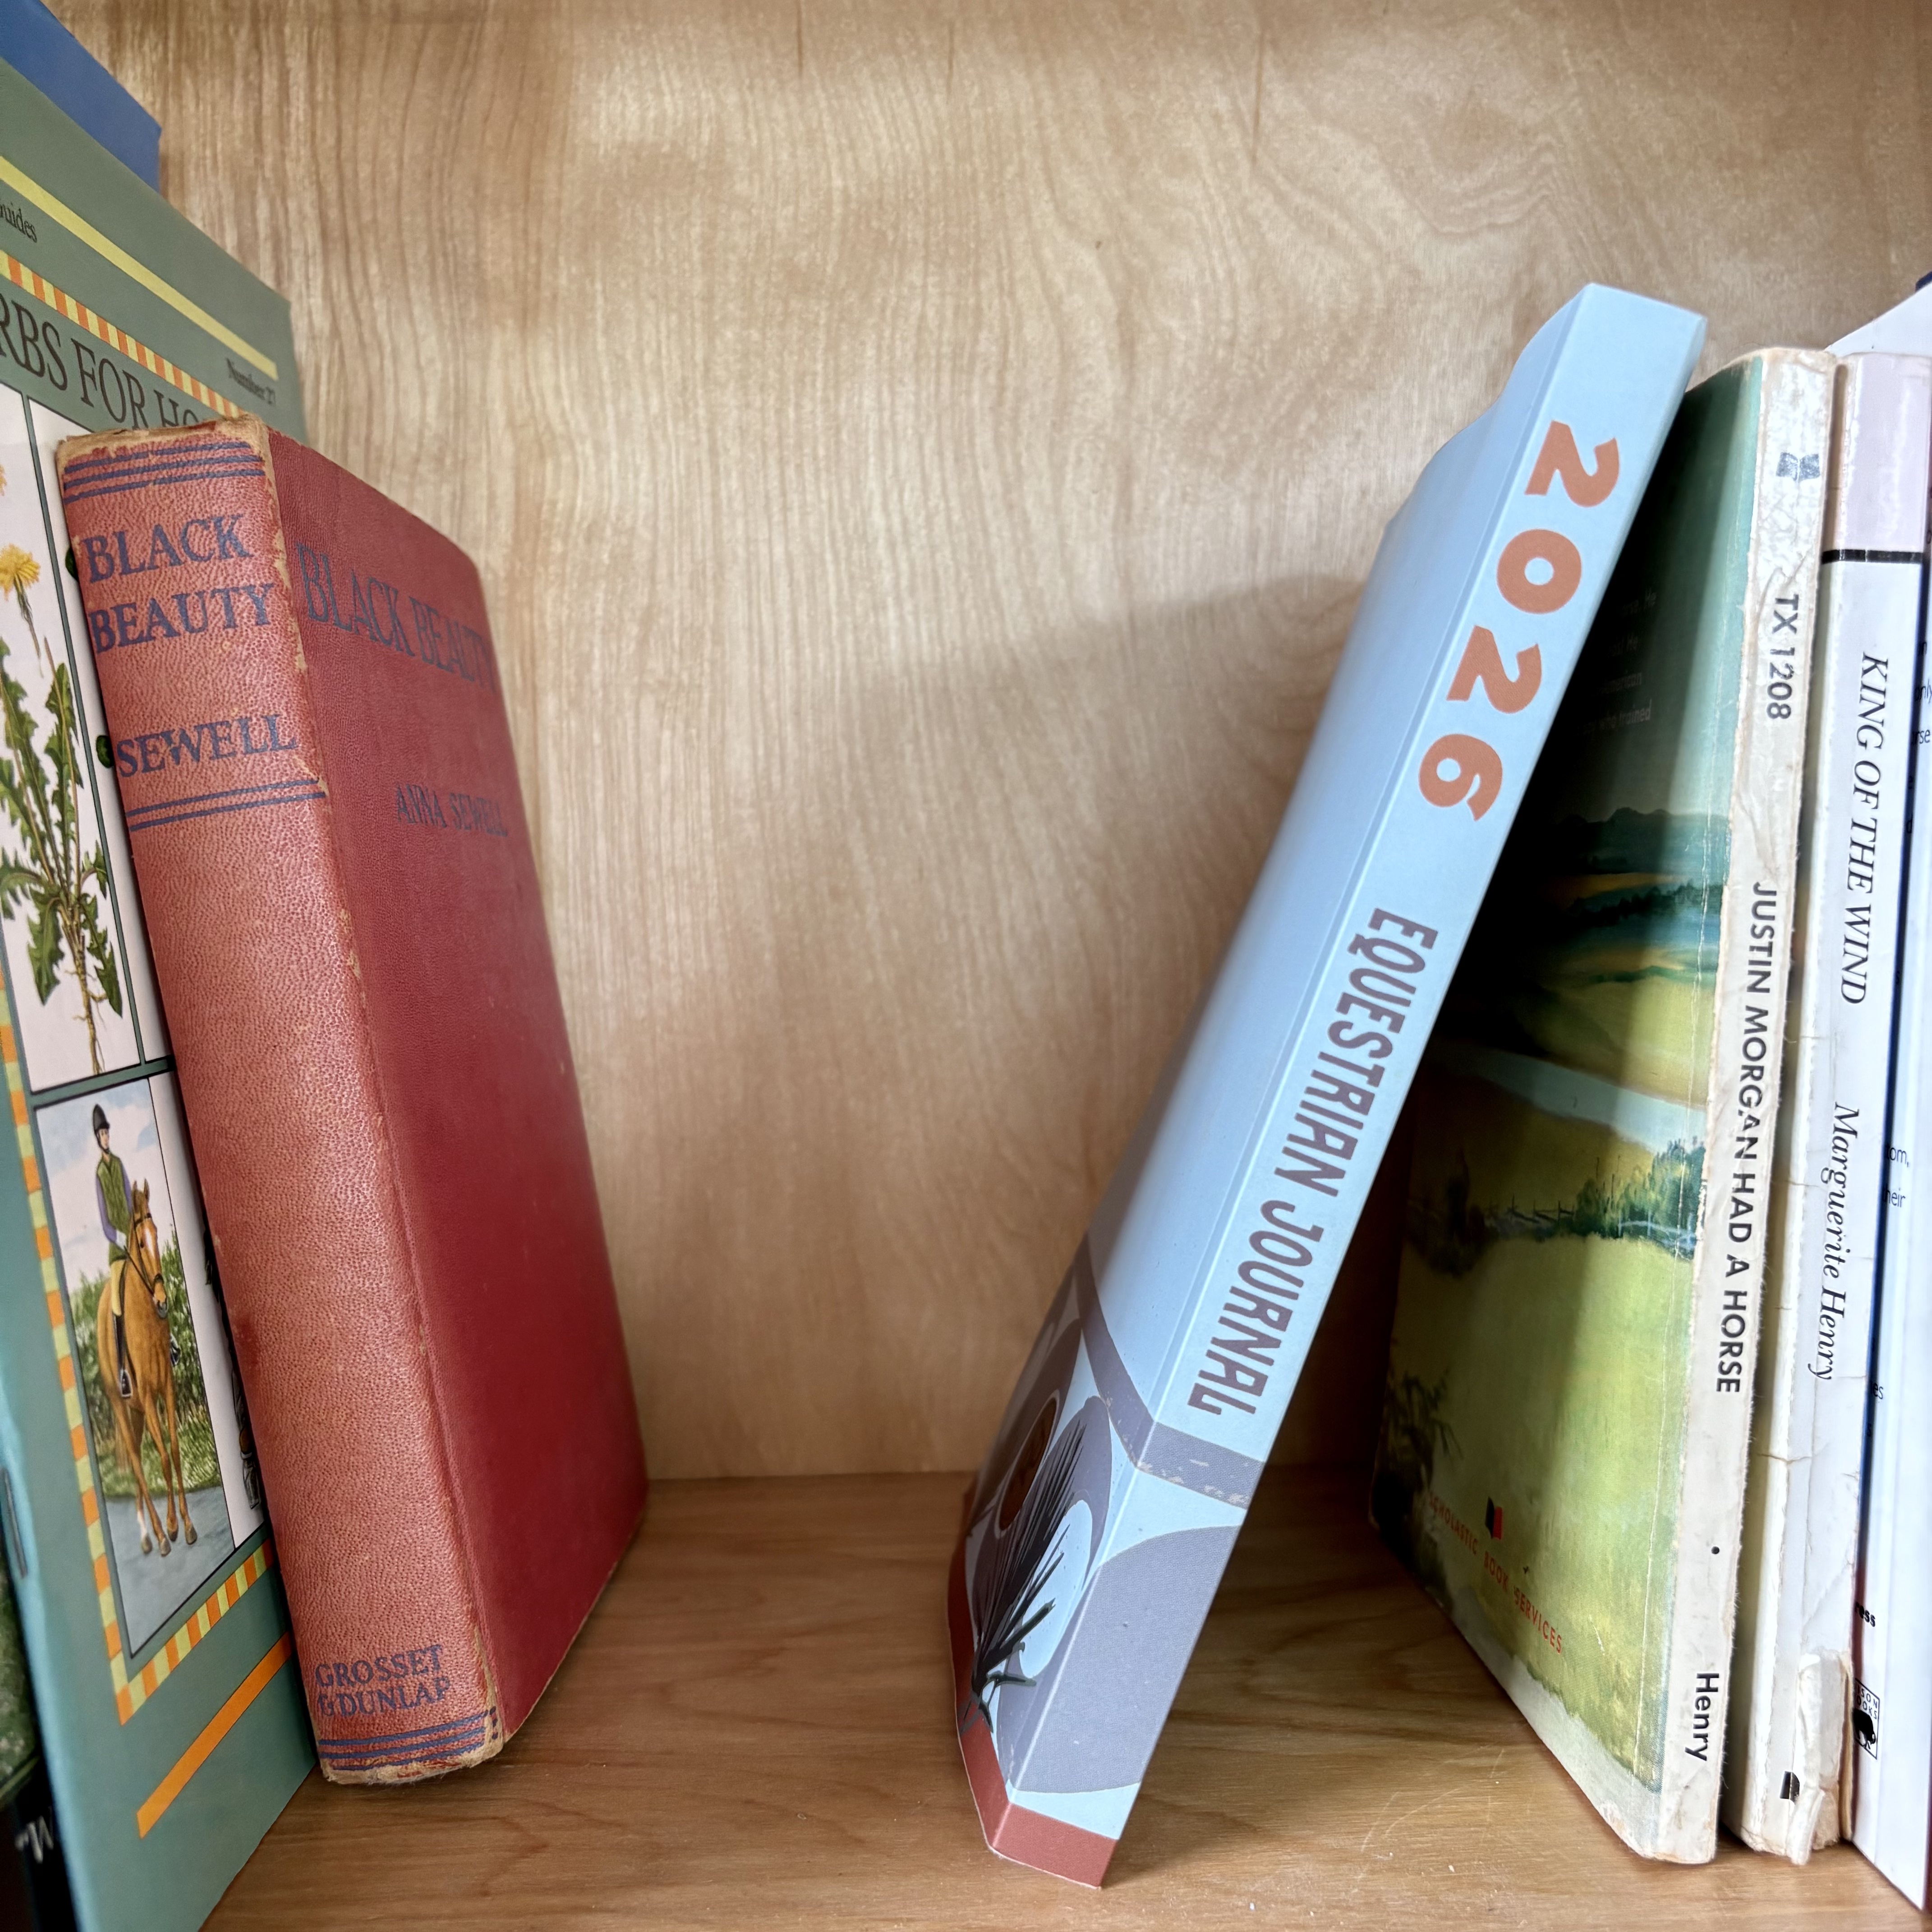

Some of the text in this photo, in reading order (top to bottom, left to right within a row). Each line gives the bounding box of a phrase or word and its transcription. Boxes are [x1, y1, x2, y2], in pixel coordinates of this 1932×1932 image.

[0, 201, 37, 243] uides
[71, 338, 149, 429] FOR
[226, 358, 265, 400] Number
[82, 514, 252, 583] BLACK
[88, 583, 275, 653] BEAUTY
[296, 543, 497, 694] BLACK BEAUTY
[1419, 420, 1619, 822] 2026
[1766, 593, 1799, 720] TX 1208
[116, 713, 298, 778] SEWELL
[396, 783, 447, 828] ANNA
[1840, 651, 1888, 1004] KING OF THE WIND
[1187, 907, 1439, 1415] EQUESTRIAN JOURNAL
[1716, 881, 1777, 1394] JUSTIN MORGAN HAD A HORSE
[1807, 1101, 1859, 1380] Marguerite Henry
[1428, 1490, 1563, 1656] SCHOLASTIC BOOK SERVICES
[315, 1644, 443, 1688] GROSSET
[338, 1676, 451, 1717] DUNLAP
[1684, 1672, 1720, 1762] Henry
